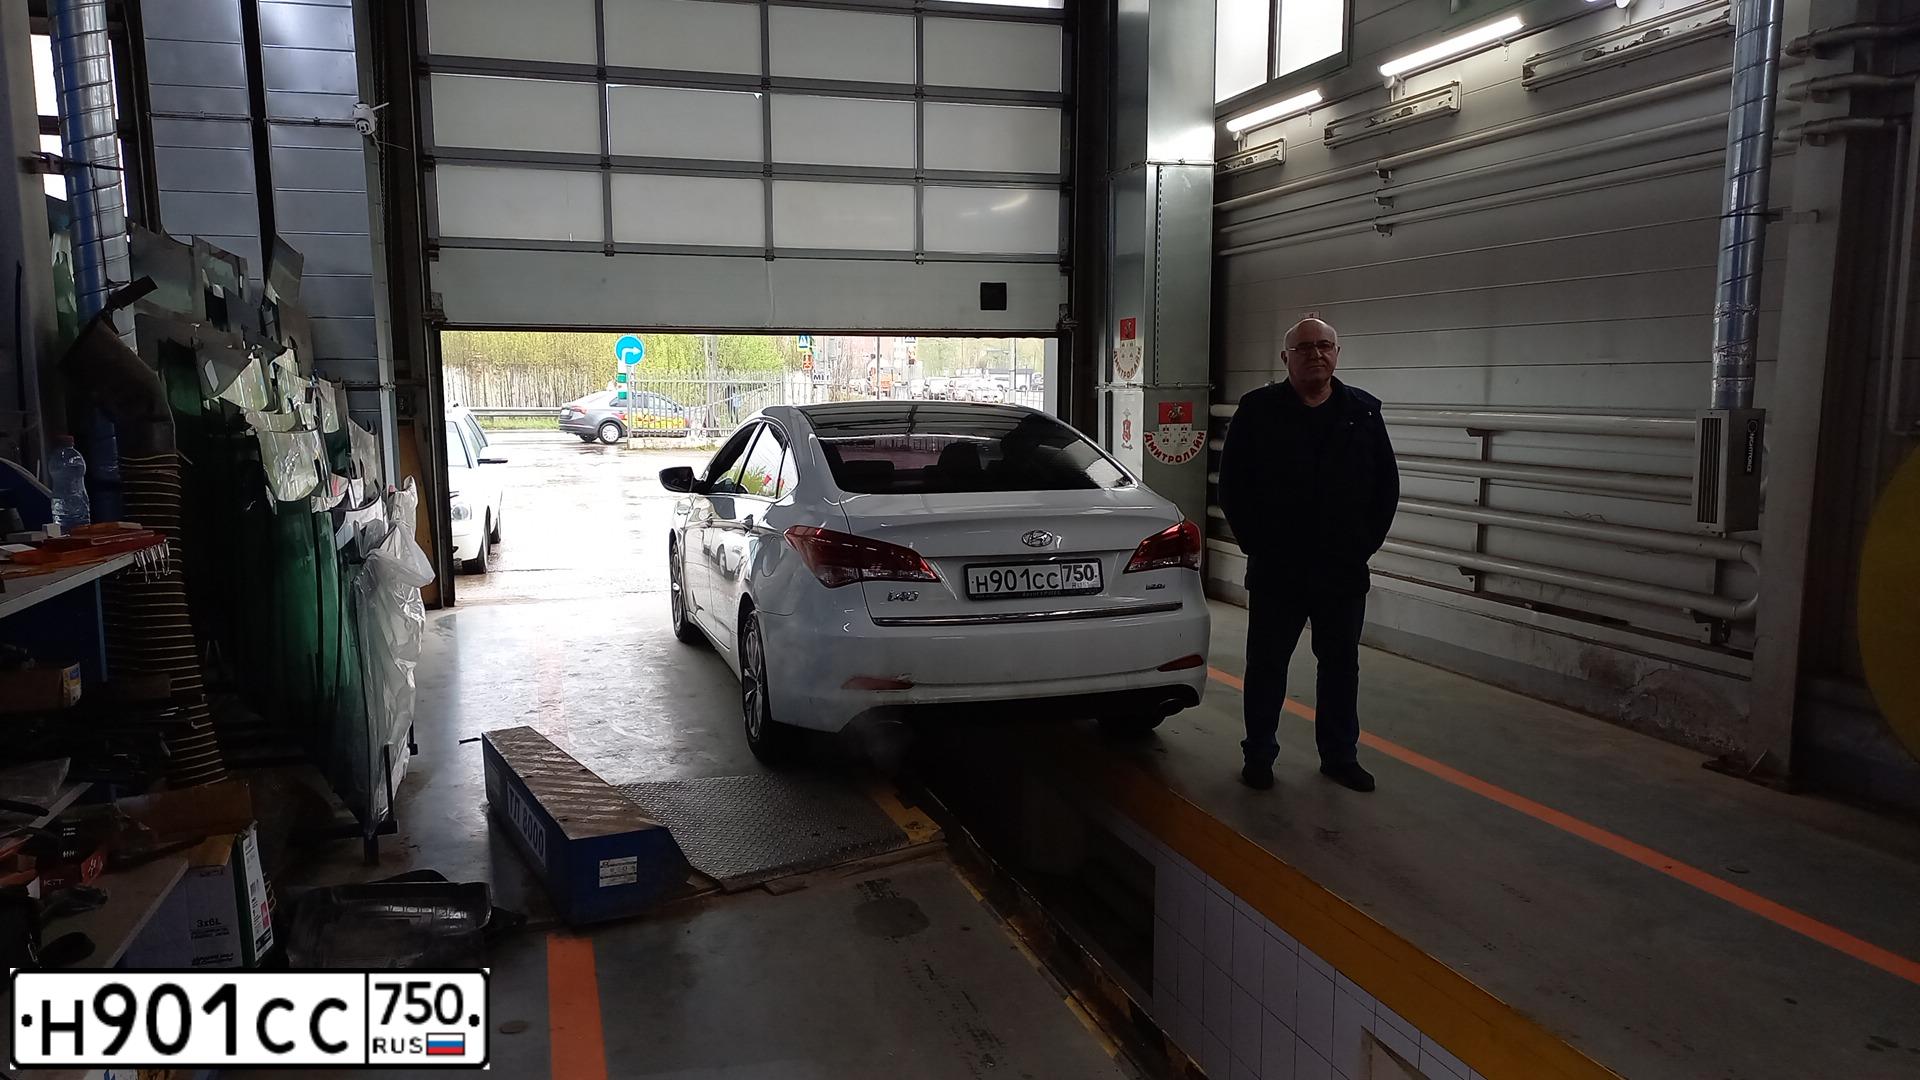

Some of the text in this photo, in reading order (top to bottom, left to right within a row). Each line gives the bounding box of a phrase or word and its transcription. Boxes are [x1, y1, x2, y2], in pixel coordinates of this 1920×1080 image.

[1144, 431, 1205, 463] ДМИТРОЛАЙН
[976, 564, 1095, 594] Н901СС 750
